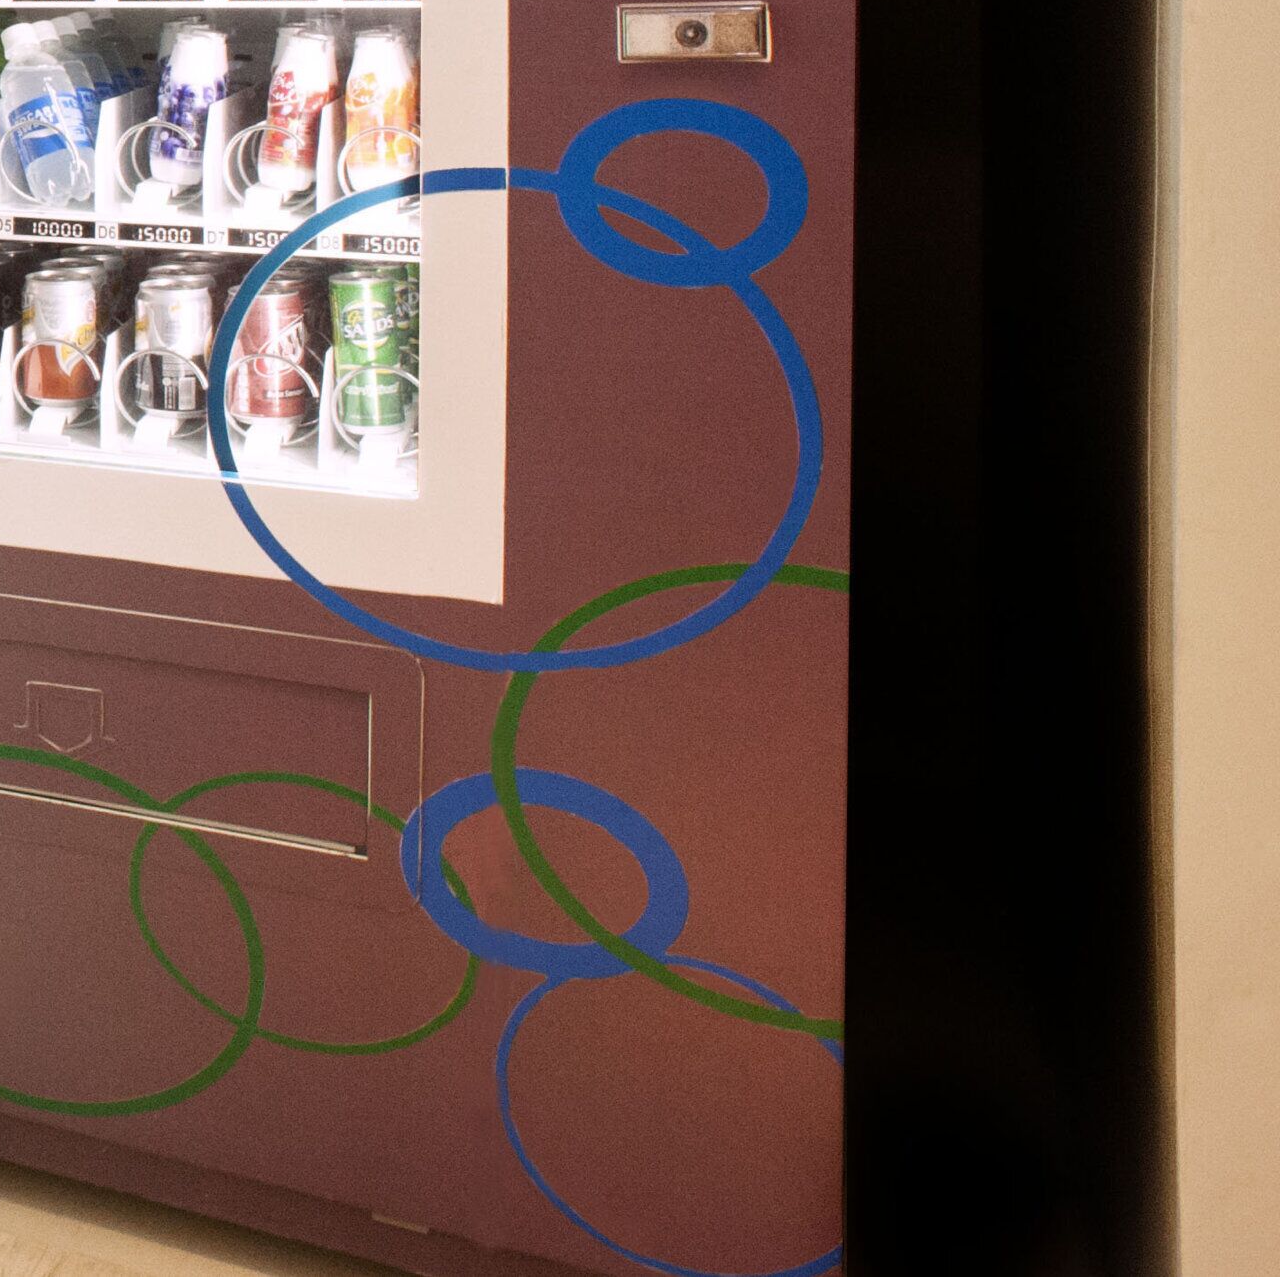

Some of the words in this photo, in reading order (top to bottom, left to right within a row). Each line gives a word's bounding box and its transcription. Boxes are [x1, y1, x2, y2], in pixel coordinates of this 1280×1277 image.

[32, 221, 83, 237] 10000
[98, 224, 116, 239] D6
[137, 226, 191, 243] 15000
[364, 237, 421, 255] 15000
[342, 314, 395, 340] SADS
